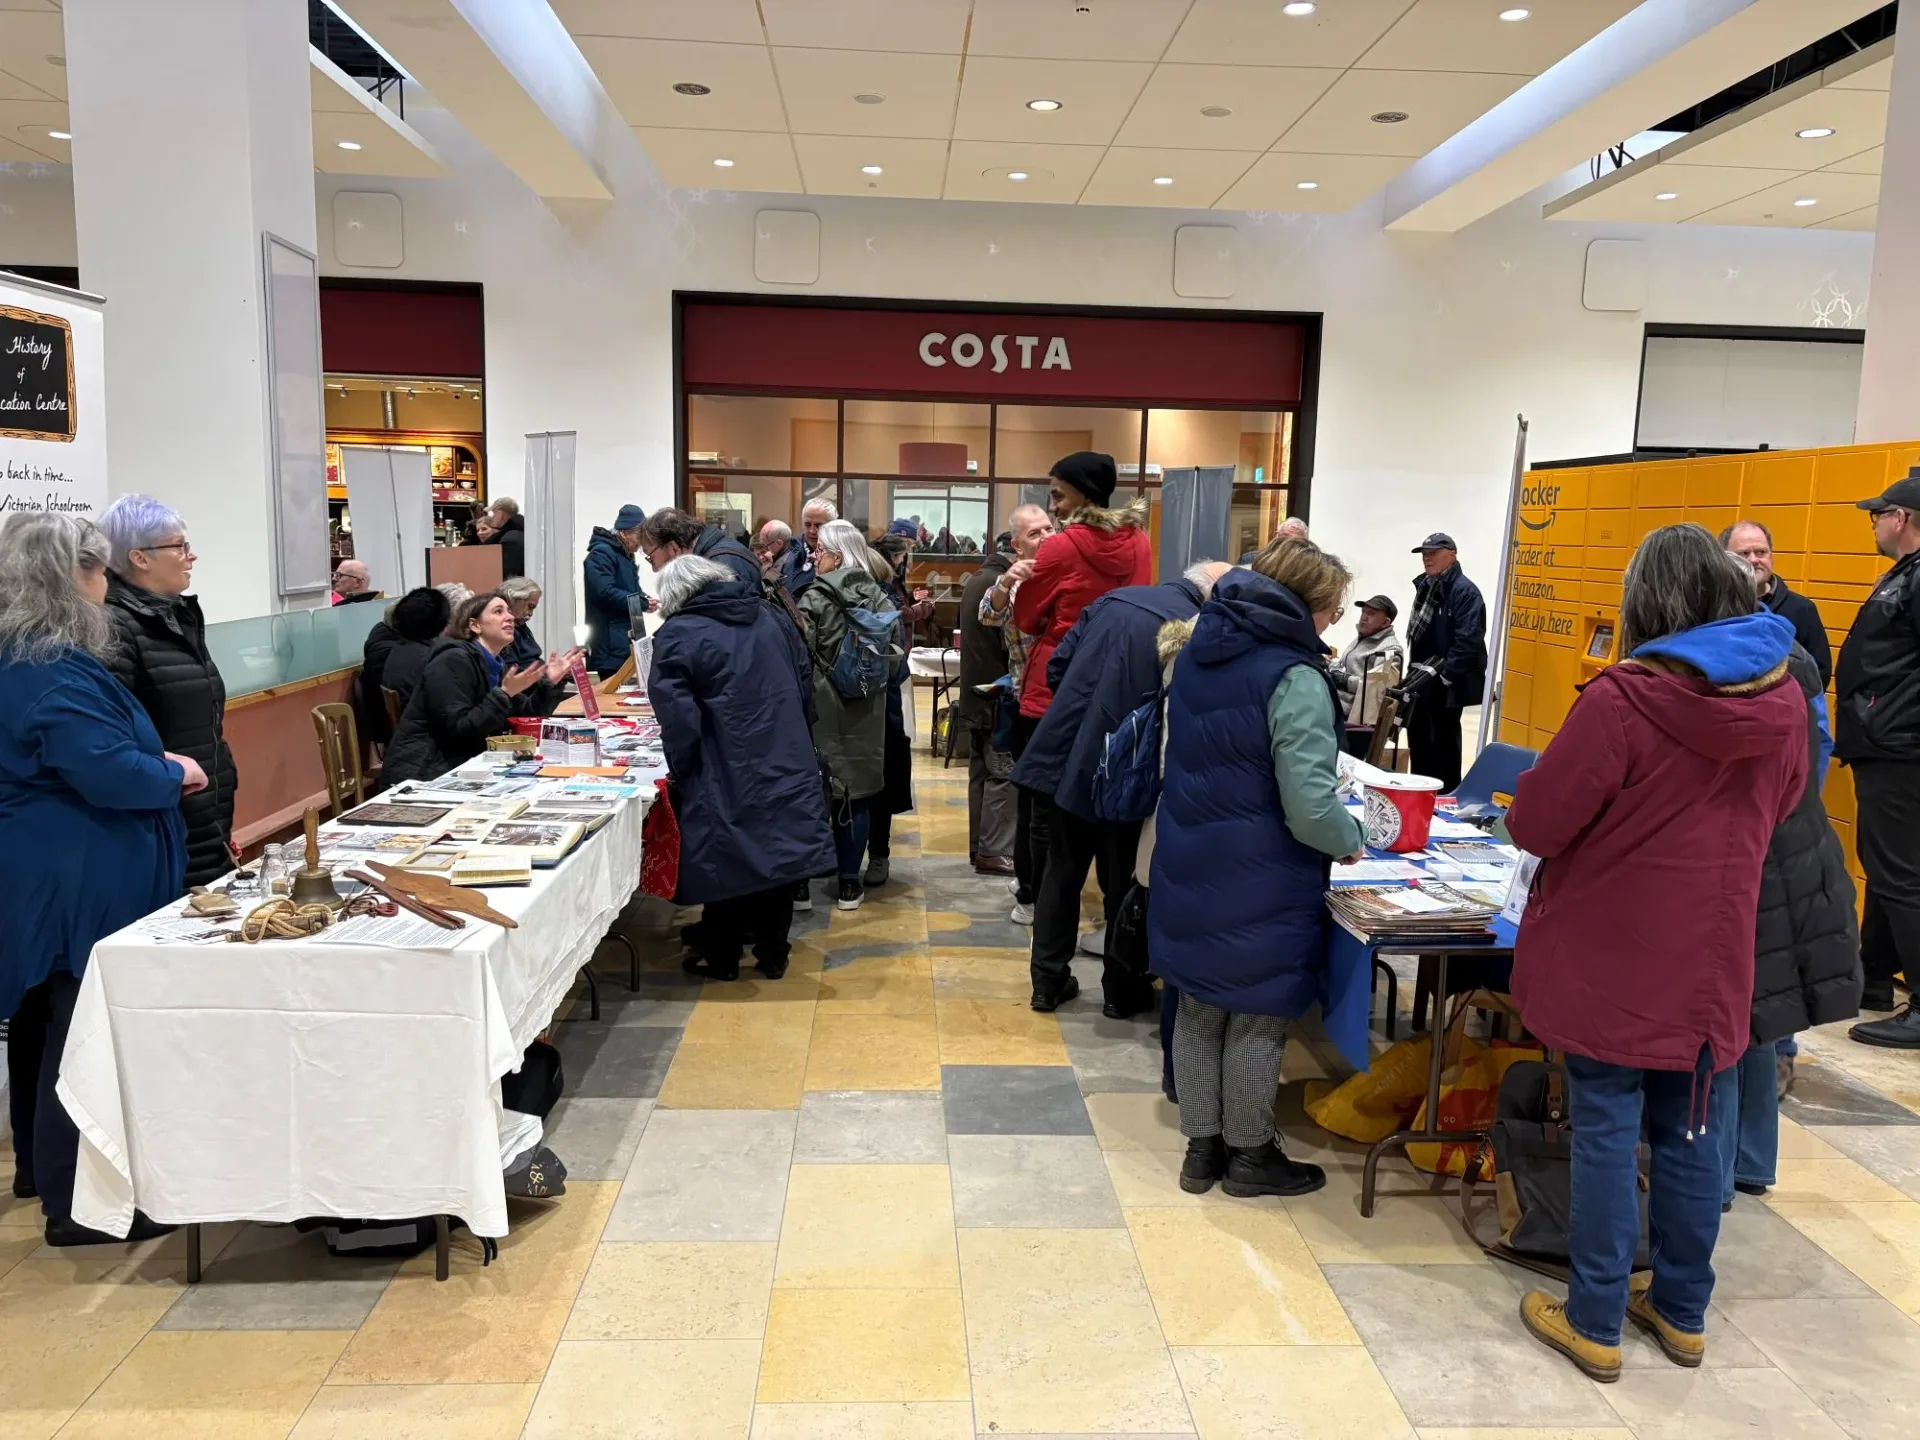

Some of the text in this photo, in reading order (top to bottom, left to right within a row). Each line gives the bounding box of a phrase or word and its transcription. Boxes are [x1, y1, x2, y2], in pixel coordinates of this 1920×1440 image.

[6, 335, 53, 371] History
[919, 332, 1072, 374] COSTA
[17, 367, 26, 384] of
[0, 391, 68, 411] cation Centre
[7, 459, 30, 480] back
[33, 465, 42, 481] in
[45, 492, 93, 512] Schoolroom
[1522, 480, 1560, 506] ocker
[1544, 548, 1555, 566] at
[1513, 577, 1556, 602] Amazon,
[1510, 608, 1573, 635] pick up here
[1390, 806, 1400, 826] FIELD
